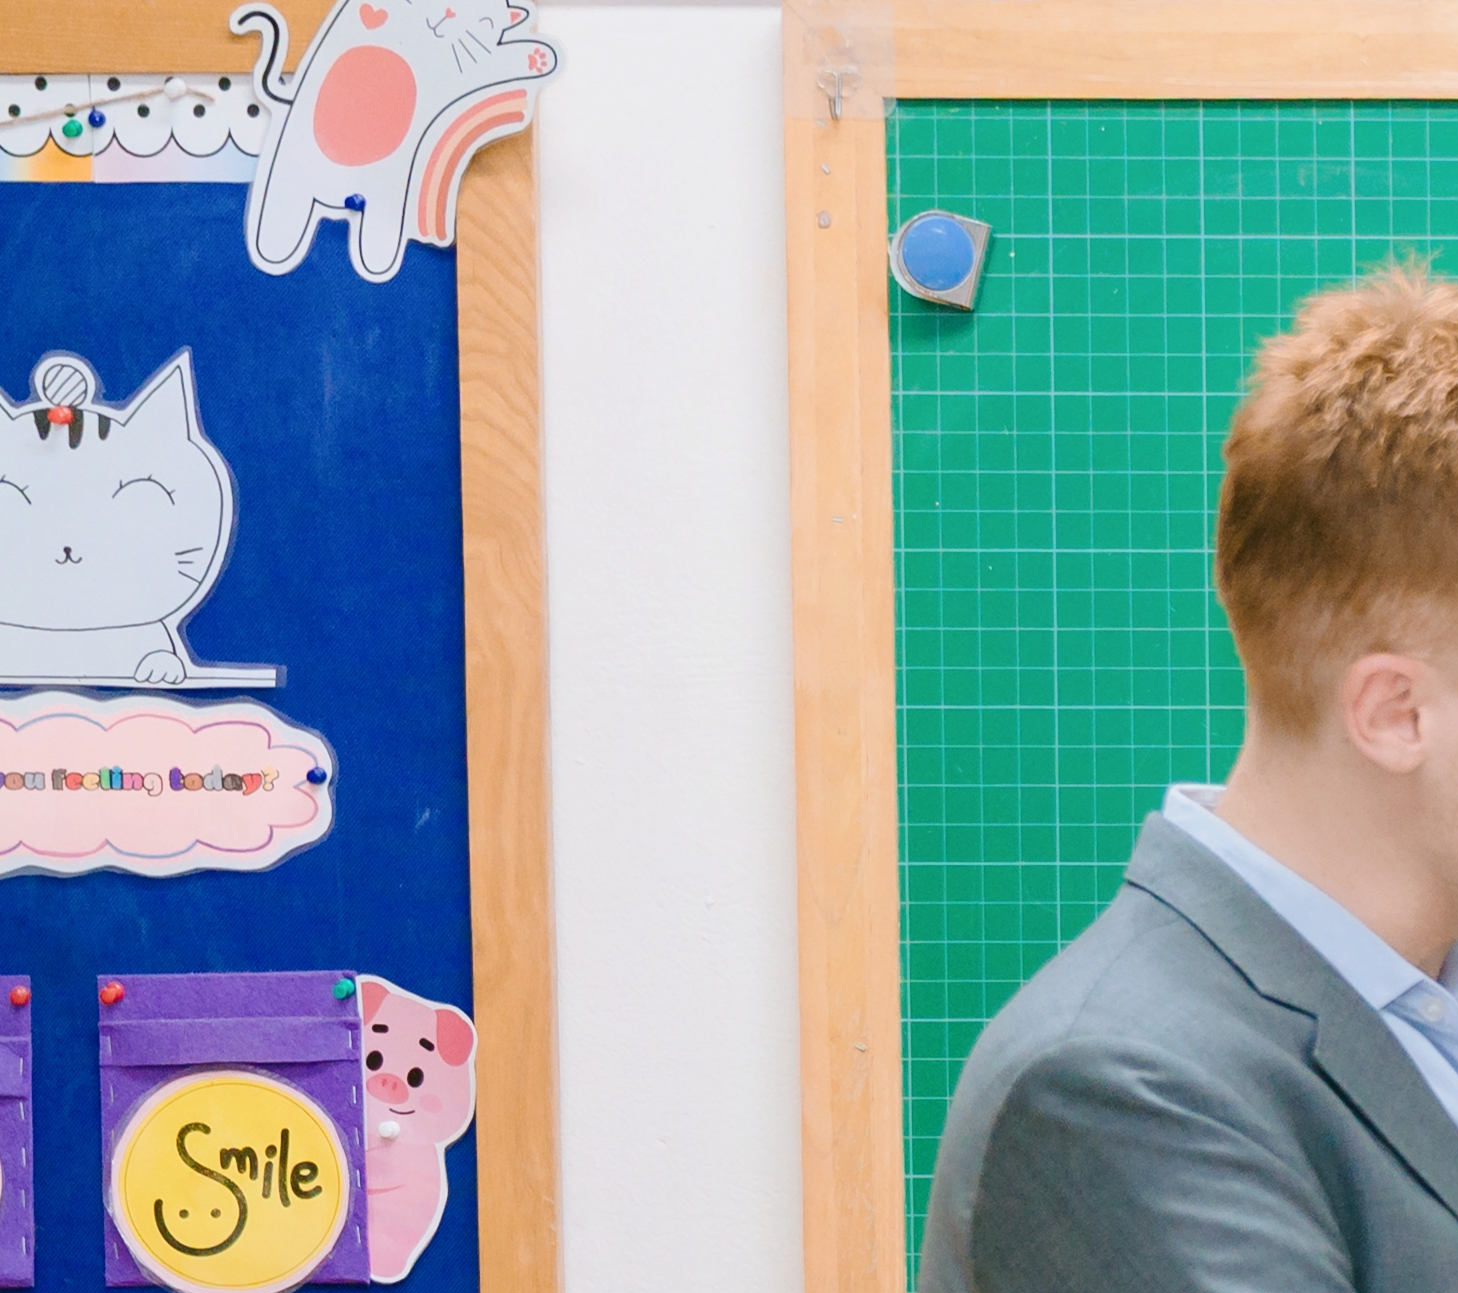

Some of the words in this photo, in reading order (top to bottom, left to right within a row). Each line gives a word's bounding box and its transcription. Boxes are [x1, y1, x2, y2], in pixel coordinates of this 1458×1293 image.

[51, 768, 163, 797] feeling
[169, 765, 279, 796] today?
[153, 1121, 323, 1257] Smile
